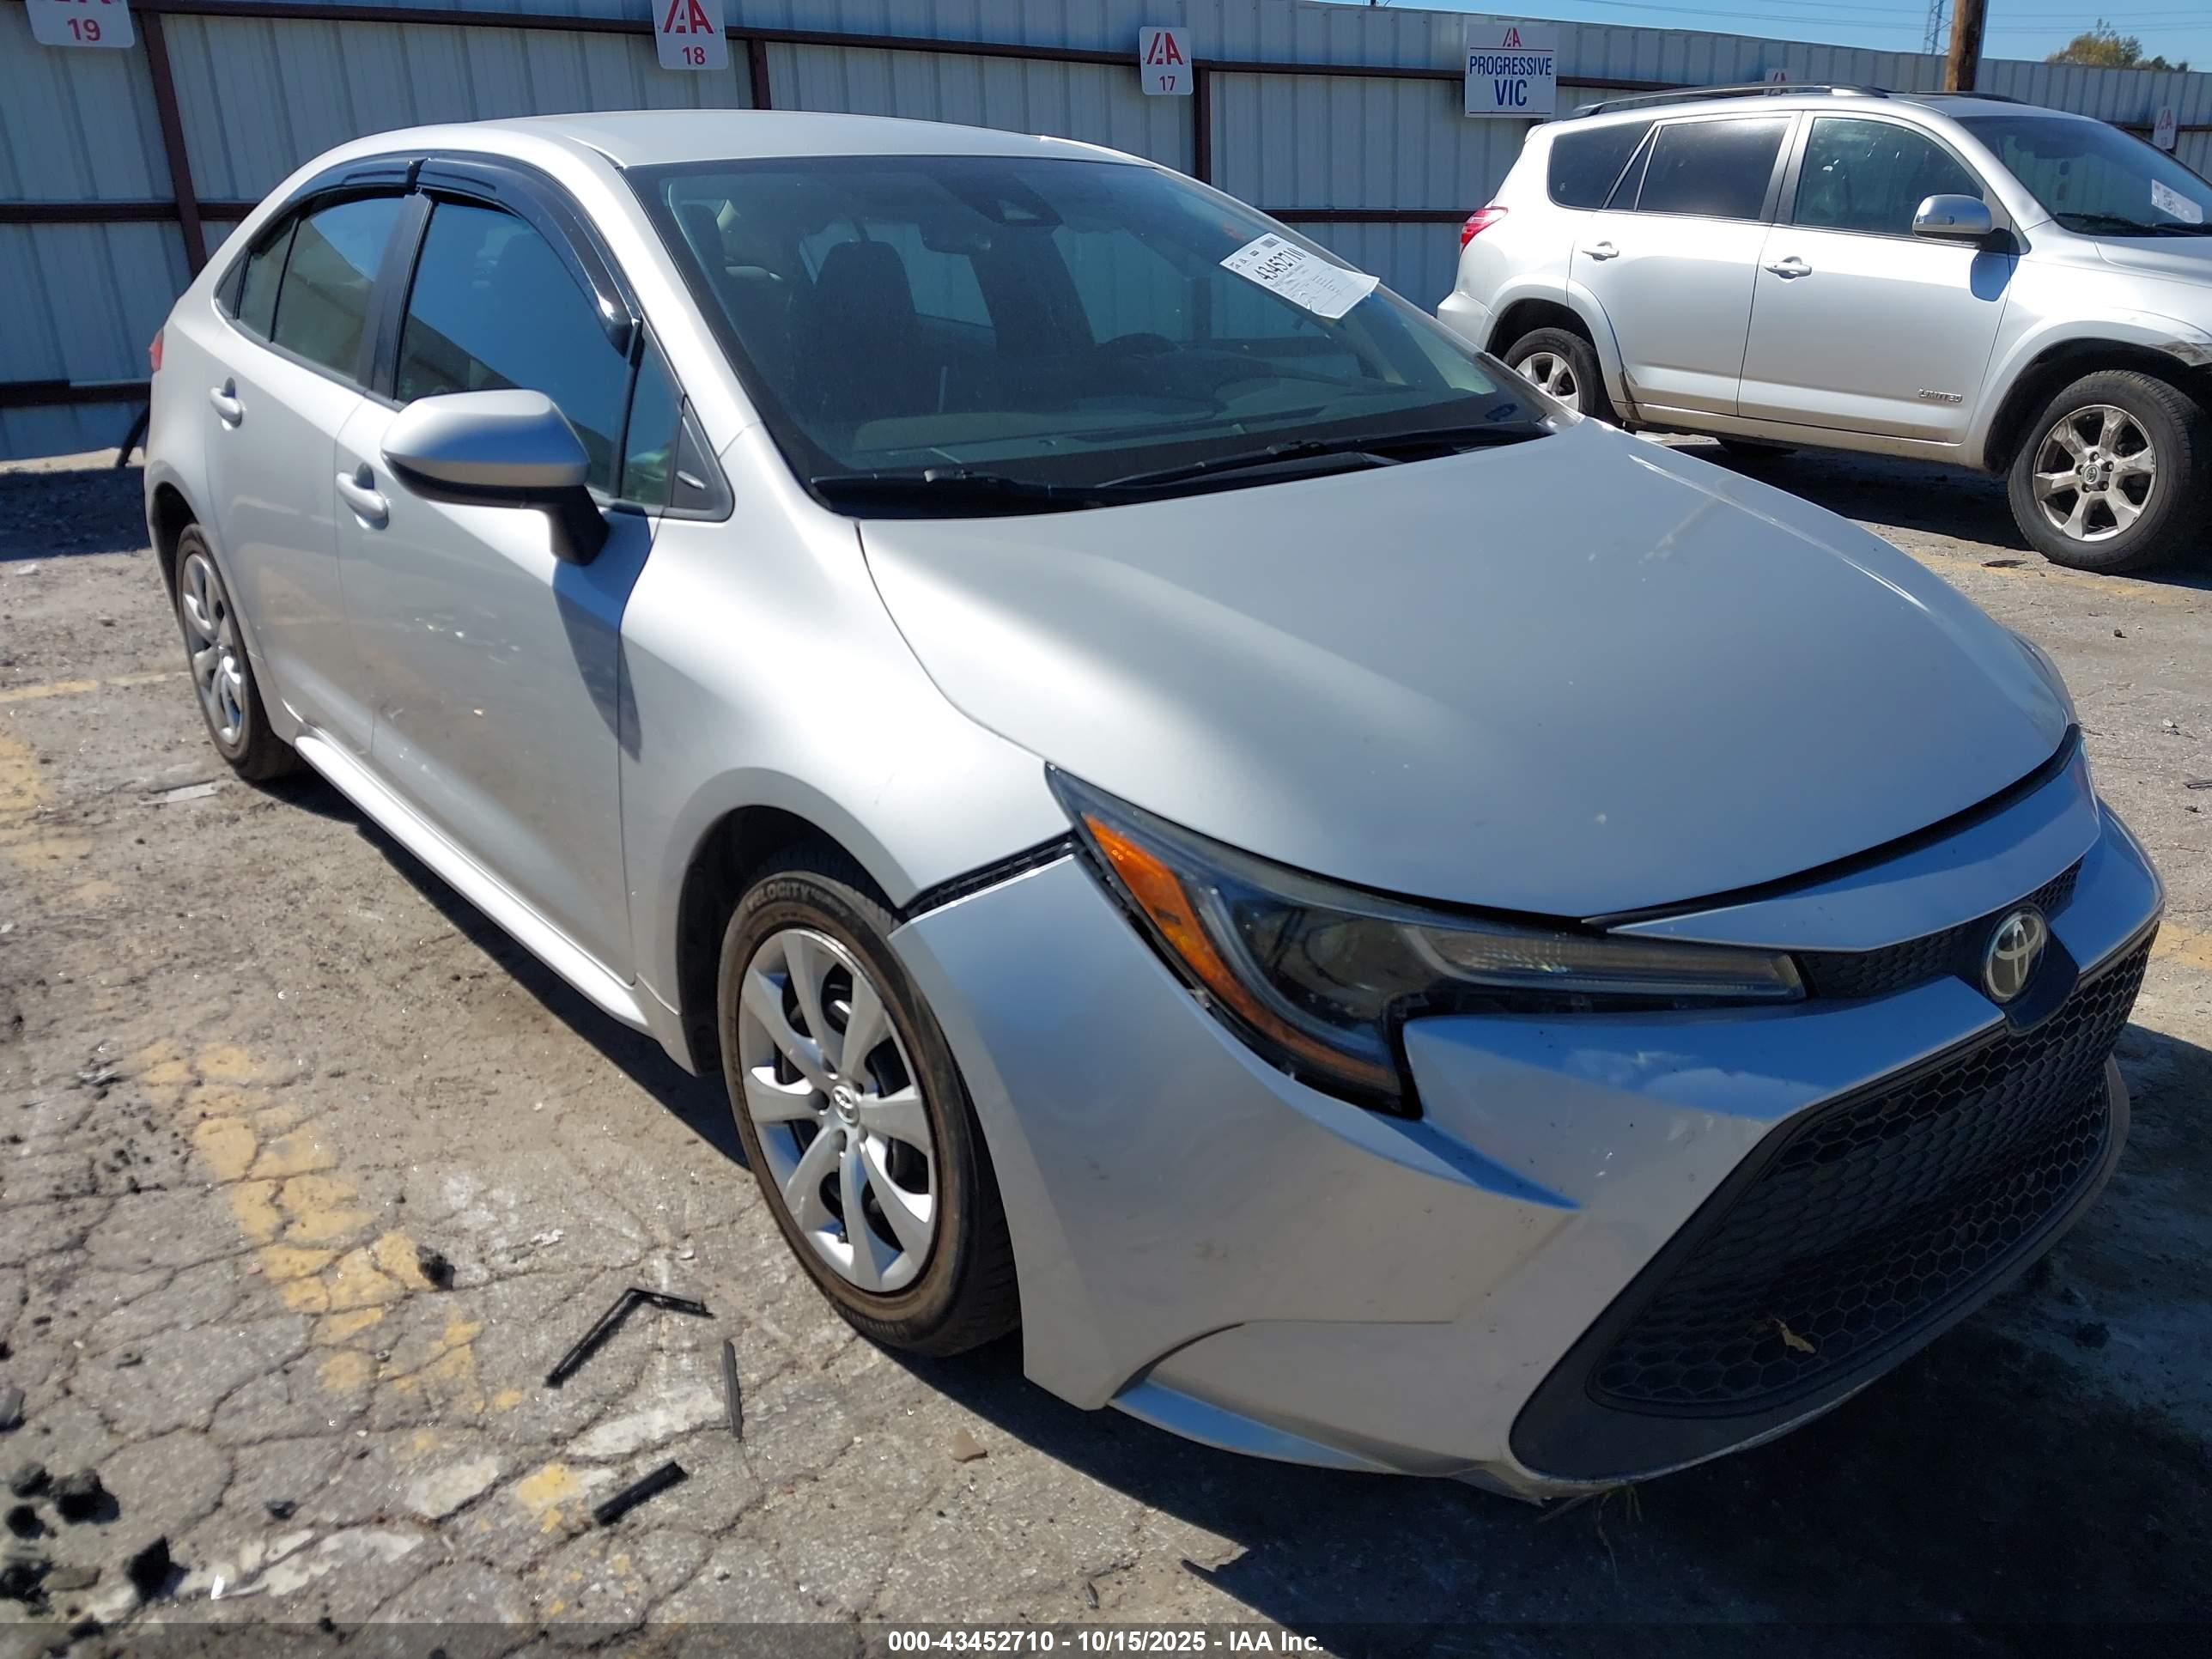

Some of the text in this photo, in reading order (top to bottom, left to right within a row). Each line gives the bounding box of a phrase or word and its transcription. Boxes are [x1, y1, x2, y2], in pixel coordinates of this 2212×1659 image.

[67, 18, 101, 41] 19
[683, 46, 706, 65] 18
[1469, 55, 1553, 76] PROGRESSIVE
[1159, 76, 1176, 91] 17
[1494, 79, 1528, 106] VIC
[1254, 247, 1306, 280] 43452710
